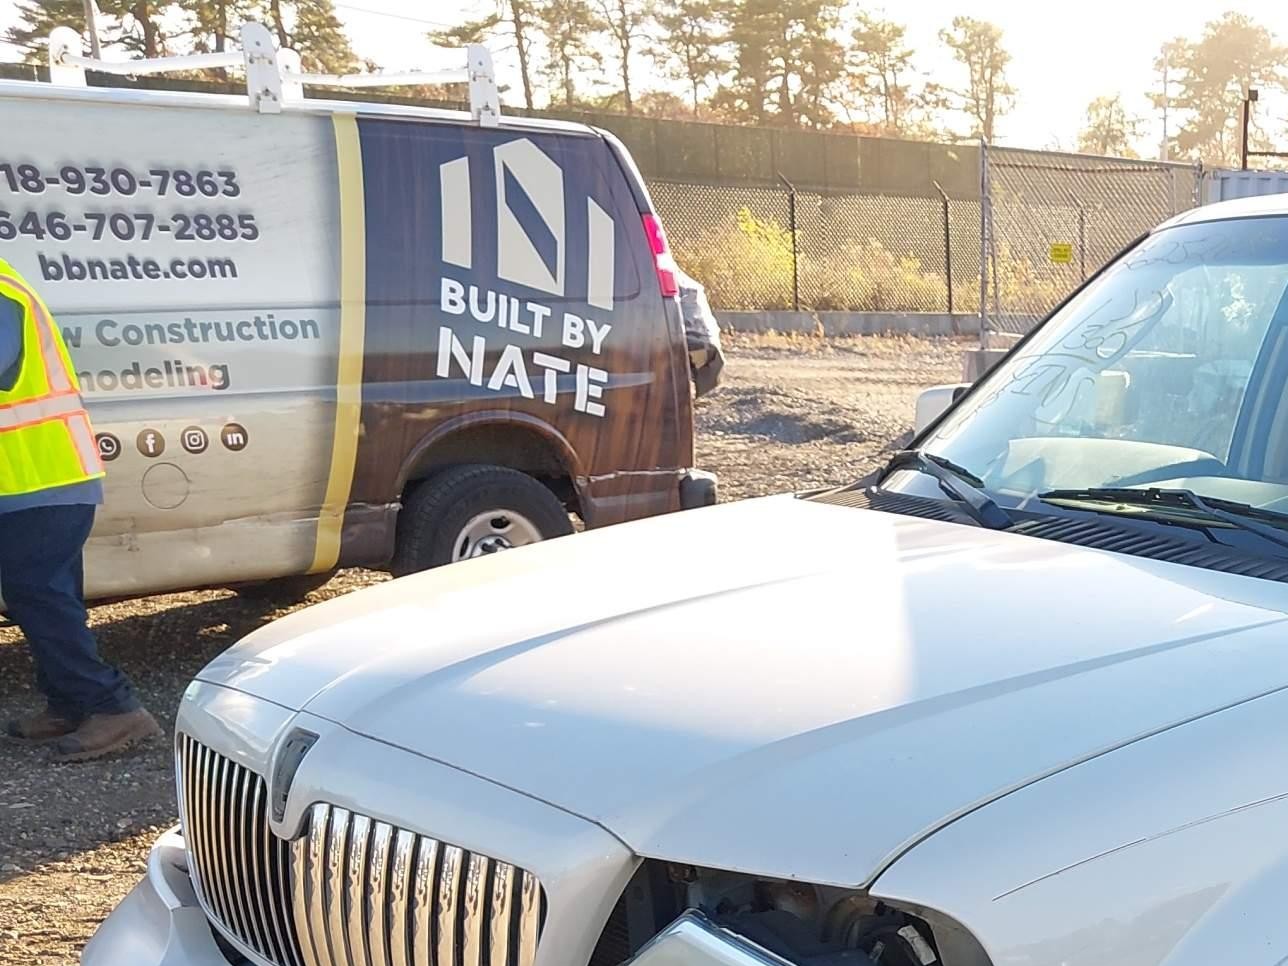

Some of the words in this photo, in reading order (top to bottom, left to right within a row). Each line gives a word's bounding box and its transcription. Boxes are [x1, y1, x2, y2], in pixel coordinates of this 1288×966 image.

[38, 253, 238, 281] bbnate.com
[95, 314, 320, 347] Construction
[440, 277, 551, 338] BUILT
[562, 312, 612, 354] BY
[436, 326, 609, 417] NATE
